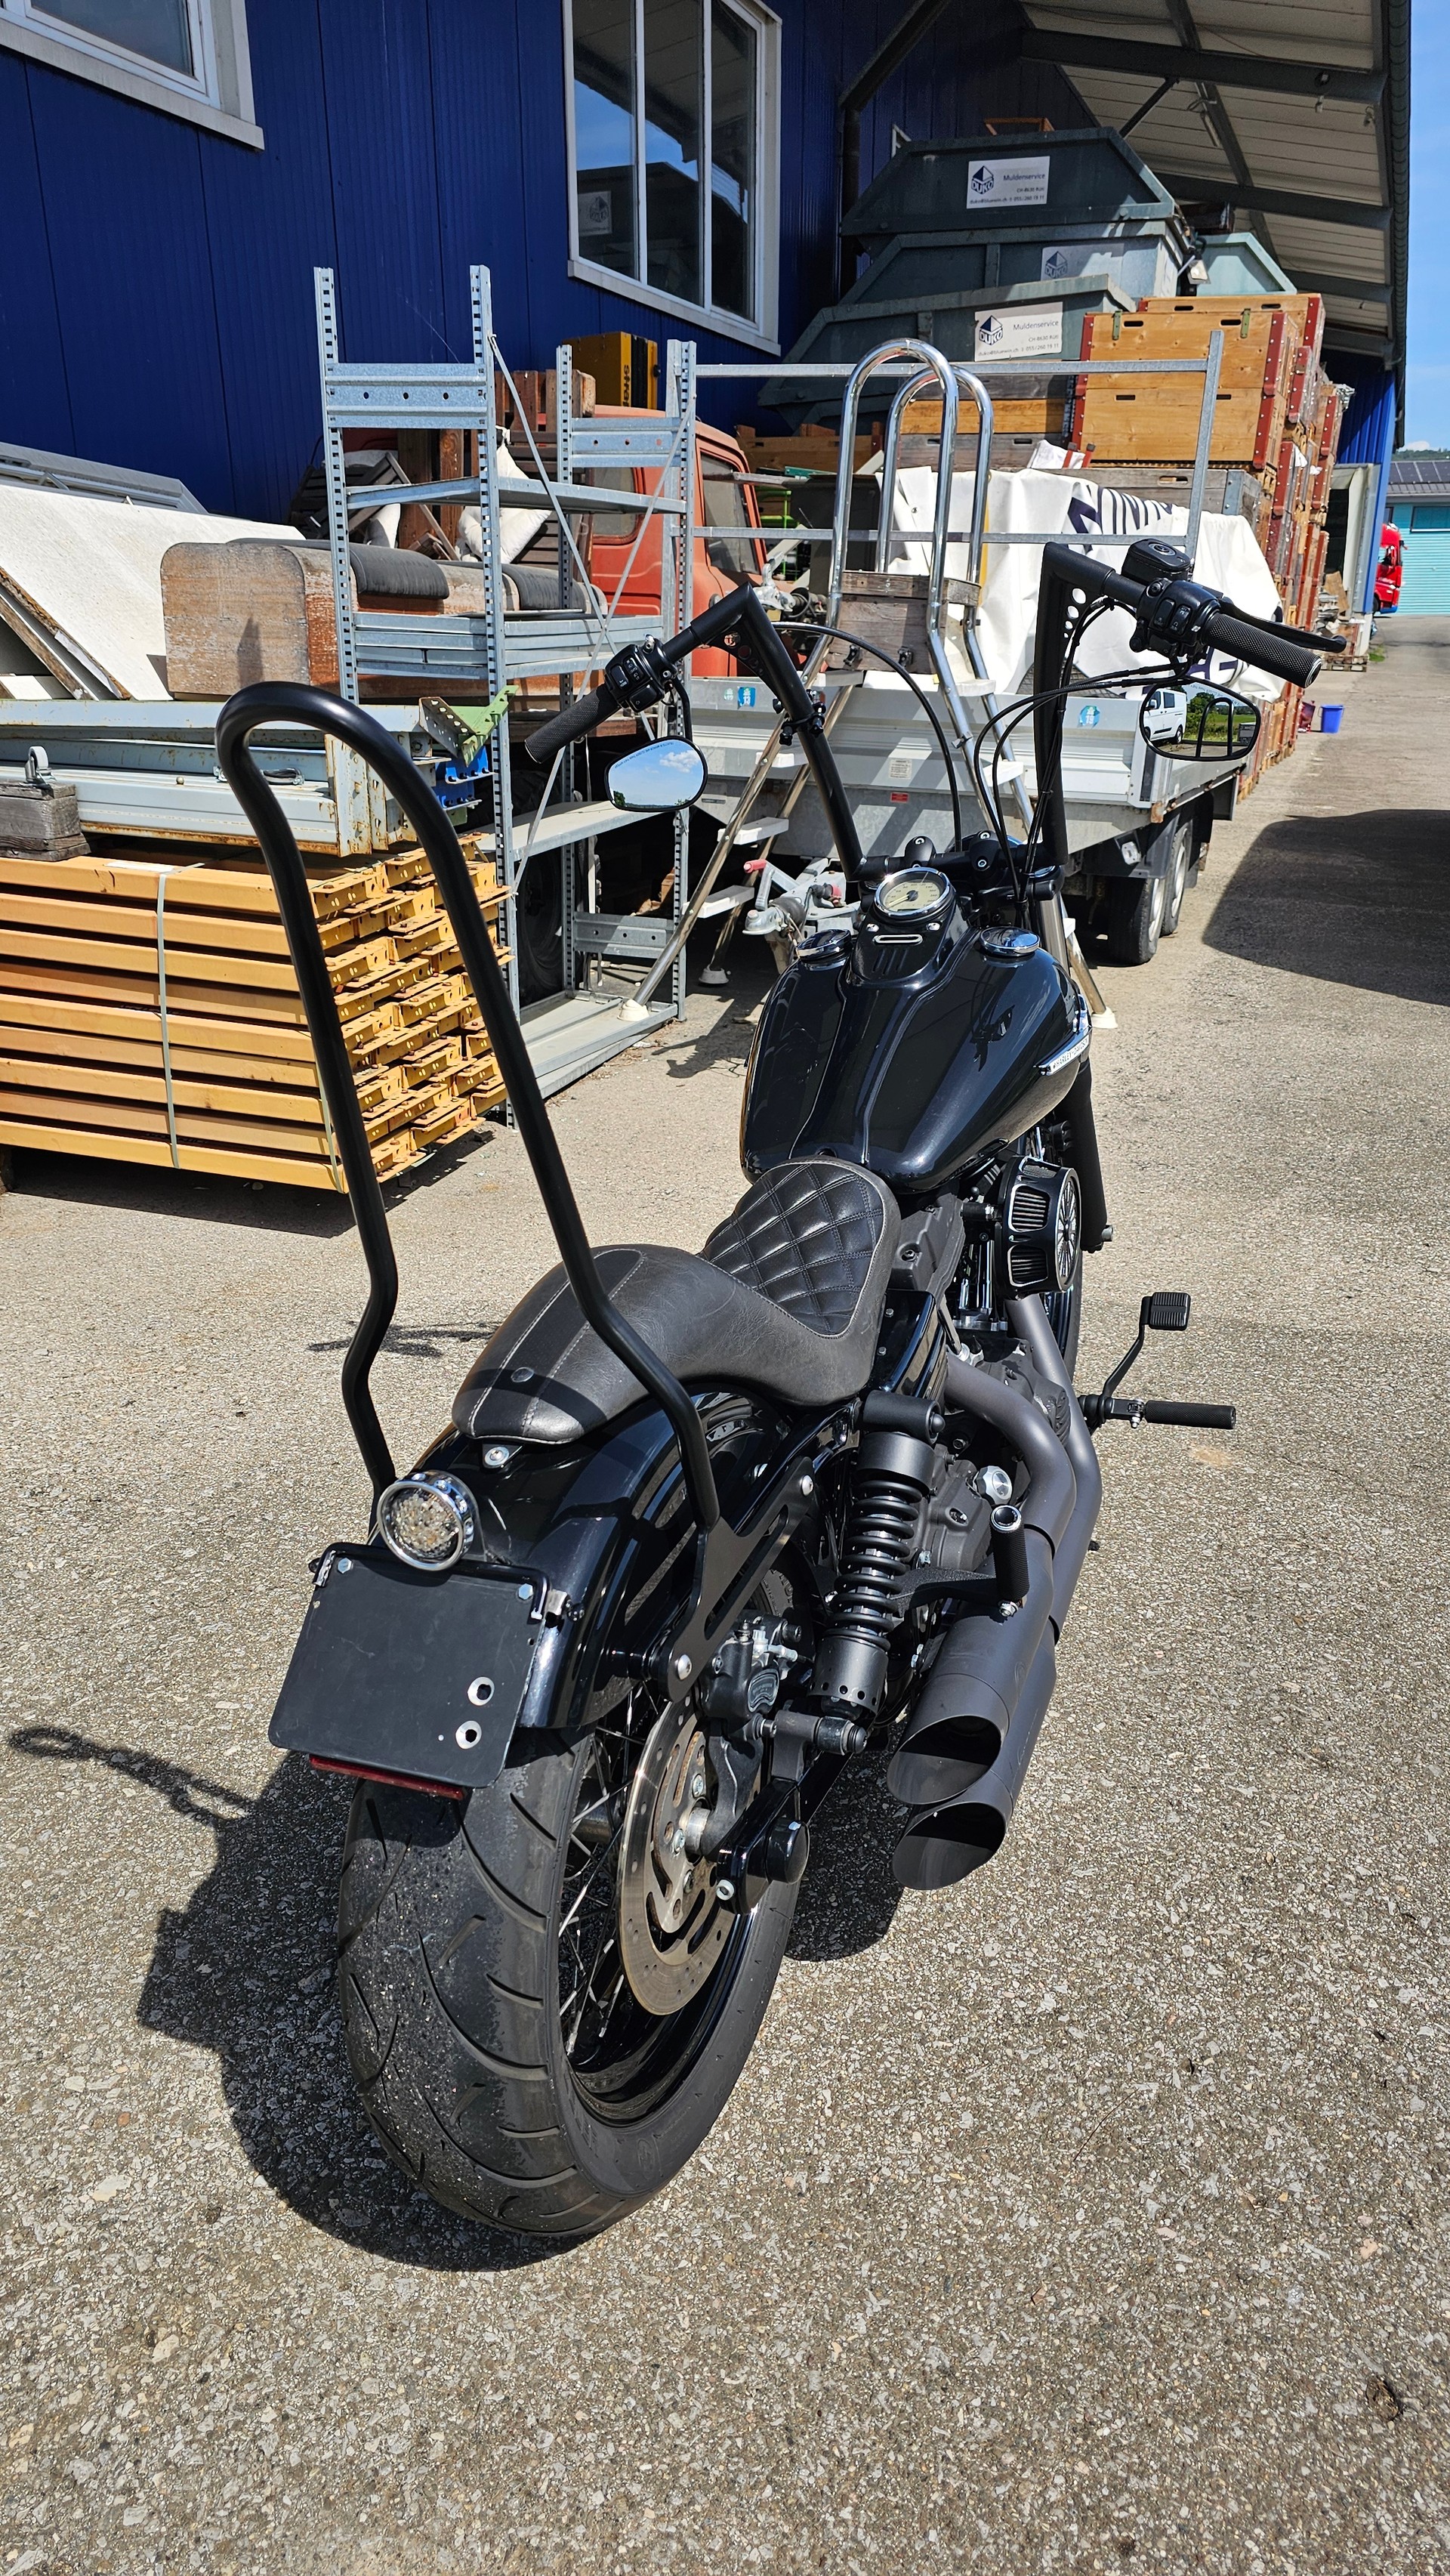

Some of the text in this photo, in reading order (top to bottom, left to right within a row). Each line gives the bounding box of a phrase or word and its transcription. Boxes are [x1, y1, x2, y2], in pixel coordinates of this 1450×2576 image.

[972, 180, 994, 194] DUKO
[1045, 265, 1067, 279] DUKO
[1013, 320, 1059, 331] Muldenservice
[979, 329, 1003, 345] DUKO
